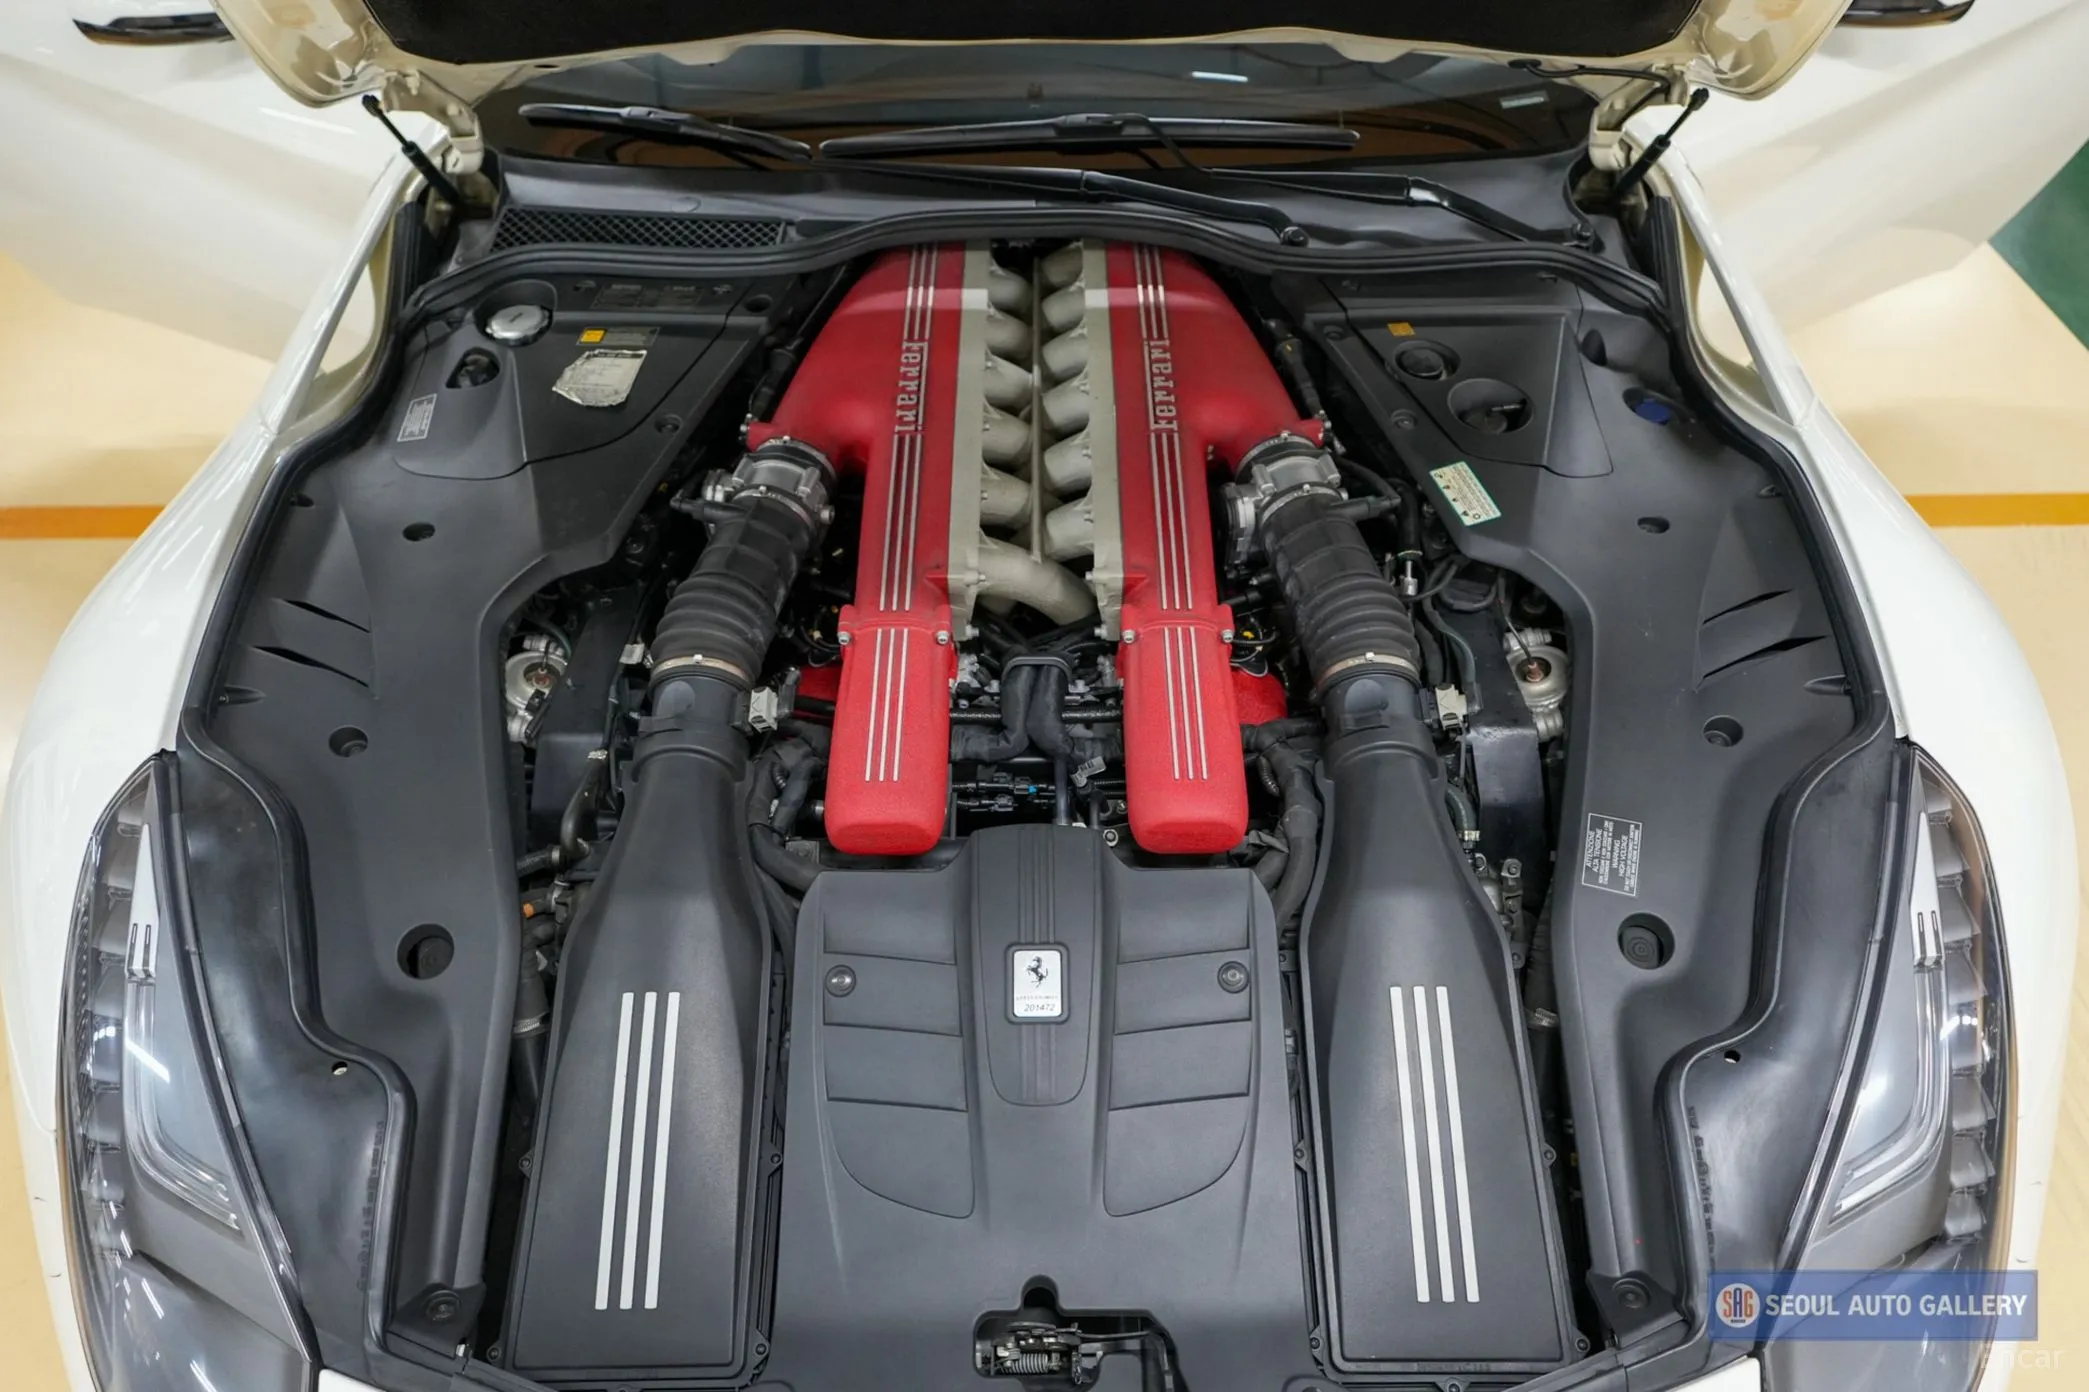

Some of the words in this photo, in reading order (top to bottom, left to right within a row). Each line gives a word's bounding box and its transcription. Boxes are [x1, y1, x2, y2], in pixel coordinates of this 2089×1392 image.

[895, 341, 929, 432] Ferrari
[1143, 339, 1178, 431] Ferrari
[1586, 830, 1595, 867] ATTENZIONE
[1594, 828, 1602, 856] TENSIONE
[1612, 839, 1620, 869] WARNING
[1620, 834, 1628, 860] VOLTAGE
[1591, 858, 1600, 872] ALTA
[1618, 860, 1626, 877] HIGH
